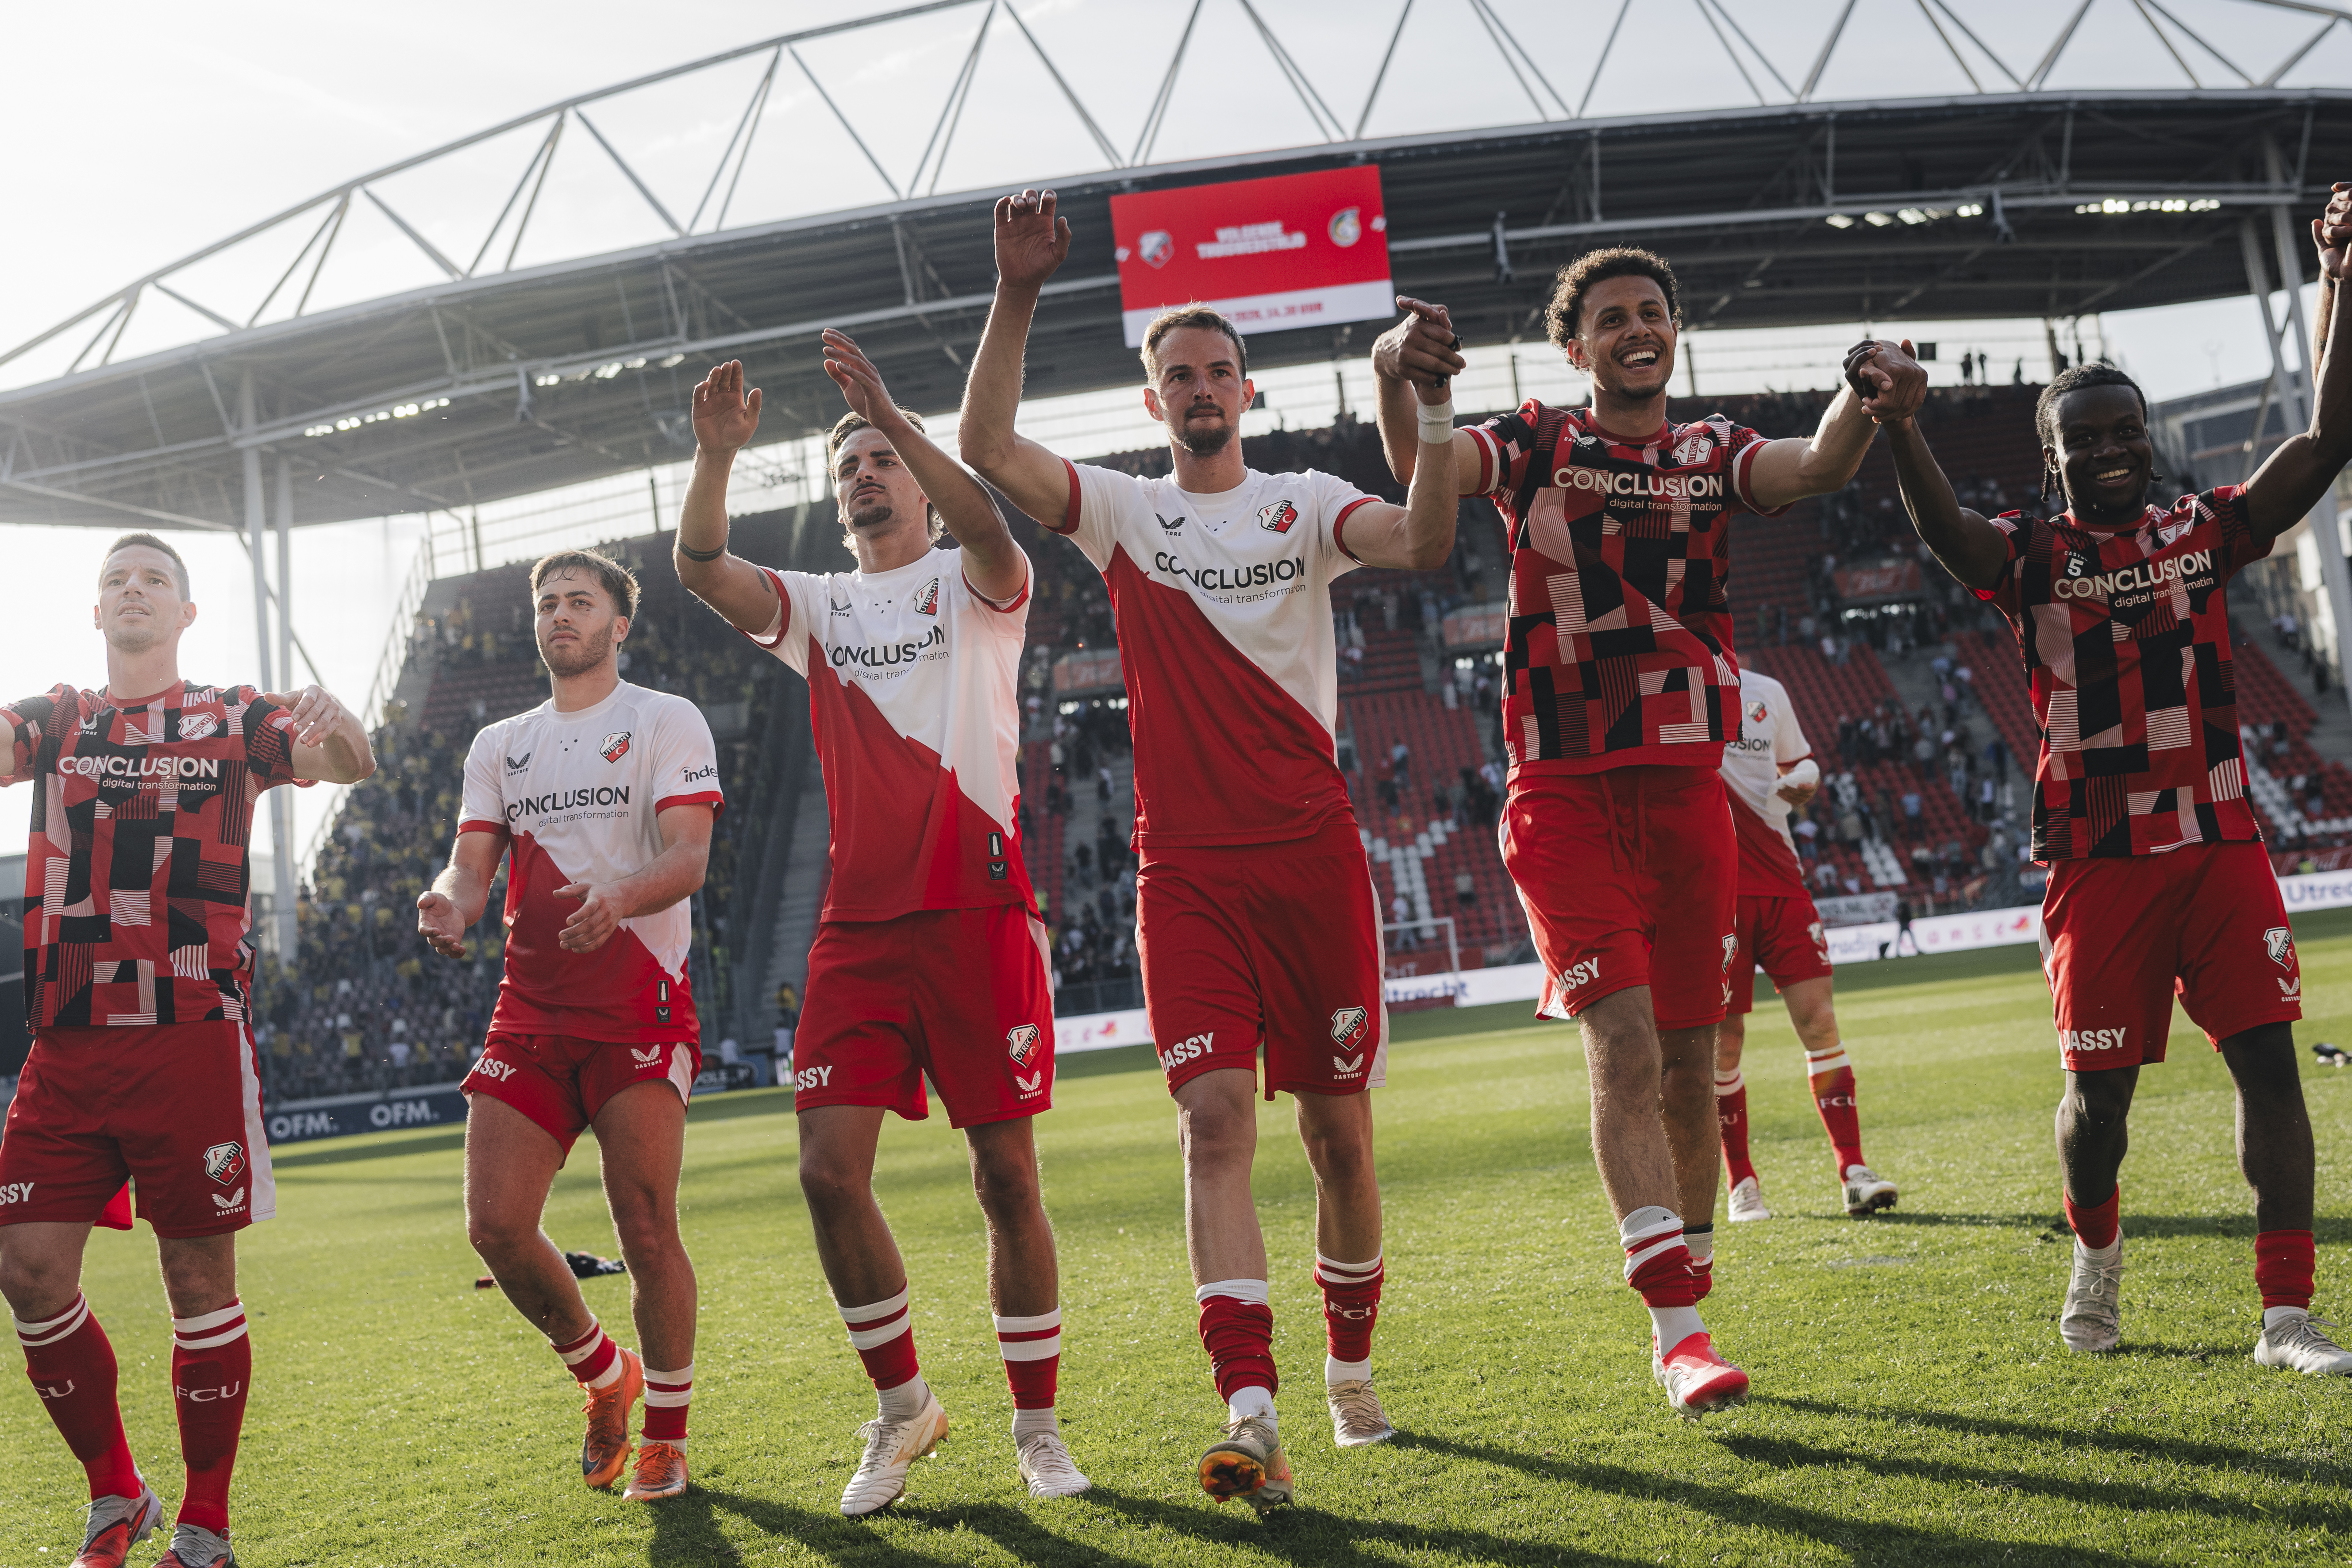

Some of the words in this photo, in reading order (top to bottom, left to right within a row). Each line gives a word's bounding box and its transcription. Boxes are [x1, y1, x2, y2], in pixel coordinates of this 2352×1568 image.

[1564, 437, 1590, 450] CASTO
[1688, 435, 1699, 464] UTRECHT
[1698, 445, 1709, 454] C
[1554, 468, 1723, 497] CONCLUSION
[1609, 498, 1644, 509] digital
[1648, 500, 1722, 511] transformation
[1268, 501, 1290, 530] UTRECHT
[1282, 514, 1292, 524] C
[2064, 551, 2088, 562] CASTO
[1155, 551, 1305, 590] CONCLUSION
[2055, 549, 2212, 599] CONCLUSION
[2067, 558, 2085, 576] 5
[920, 589, 925, 598] F
[920, 580, 939, 613] UTRECHT
[1236, 584, 1306, 603] transformation
[2115, 592, 2150, 608] digital
[886, 651, 949, 679] tranrmation
[185, 714, 212, 739] UTRECHT
[602, 733, 630, 757] UTRECHT
[616, 747, 624, 755] C
[59, 755, 218, 778] CONCLUSION
[102, 778, 135, 789] digital
[138, 780, 216, 791] transformation
[563, 809, 629, 822] transformation
[2273, 933, 2279, 943] F
[2275, 932, 2291, 962] UTRECHT
[2287, 949, 2293, 959] C
[1337, 1010, 1365, 1042] UTRECHT
[1342, 1013, 1348, 1024] F
[1017, 1031, 1023, 1042] F
[1353, 1029, 1361, 1039] C
[2063, 1027, 2126, 1051] DASSY
[1015, 1027, 1037, 1060] UTRECHT
[1029, 1046, 1035, 1056] C
[474, 1057, 517, 1082] ASSY
[635, 1059, 662, 1069] CASTORE
[794, 1065, 832, 1094] ASSY
[1020, 1089, 1043, 1100] CASTORE
[1820, 1096, 1857, 1109] FCU
[212, 1145, 239, 1178] UTRECHT
[214, 1150, 220, 1160] F
[228, 1163, 237, 1173] C
[0, 1182, 35, 1206] SSY
[216, 1206, 246, 1216] CASTORE
[32, 1379, 75, 1398] CU
[177, 1380, 239, 1402] FCU
